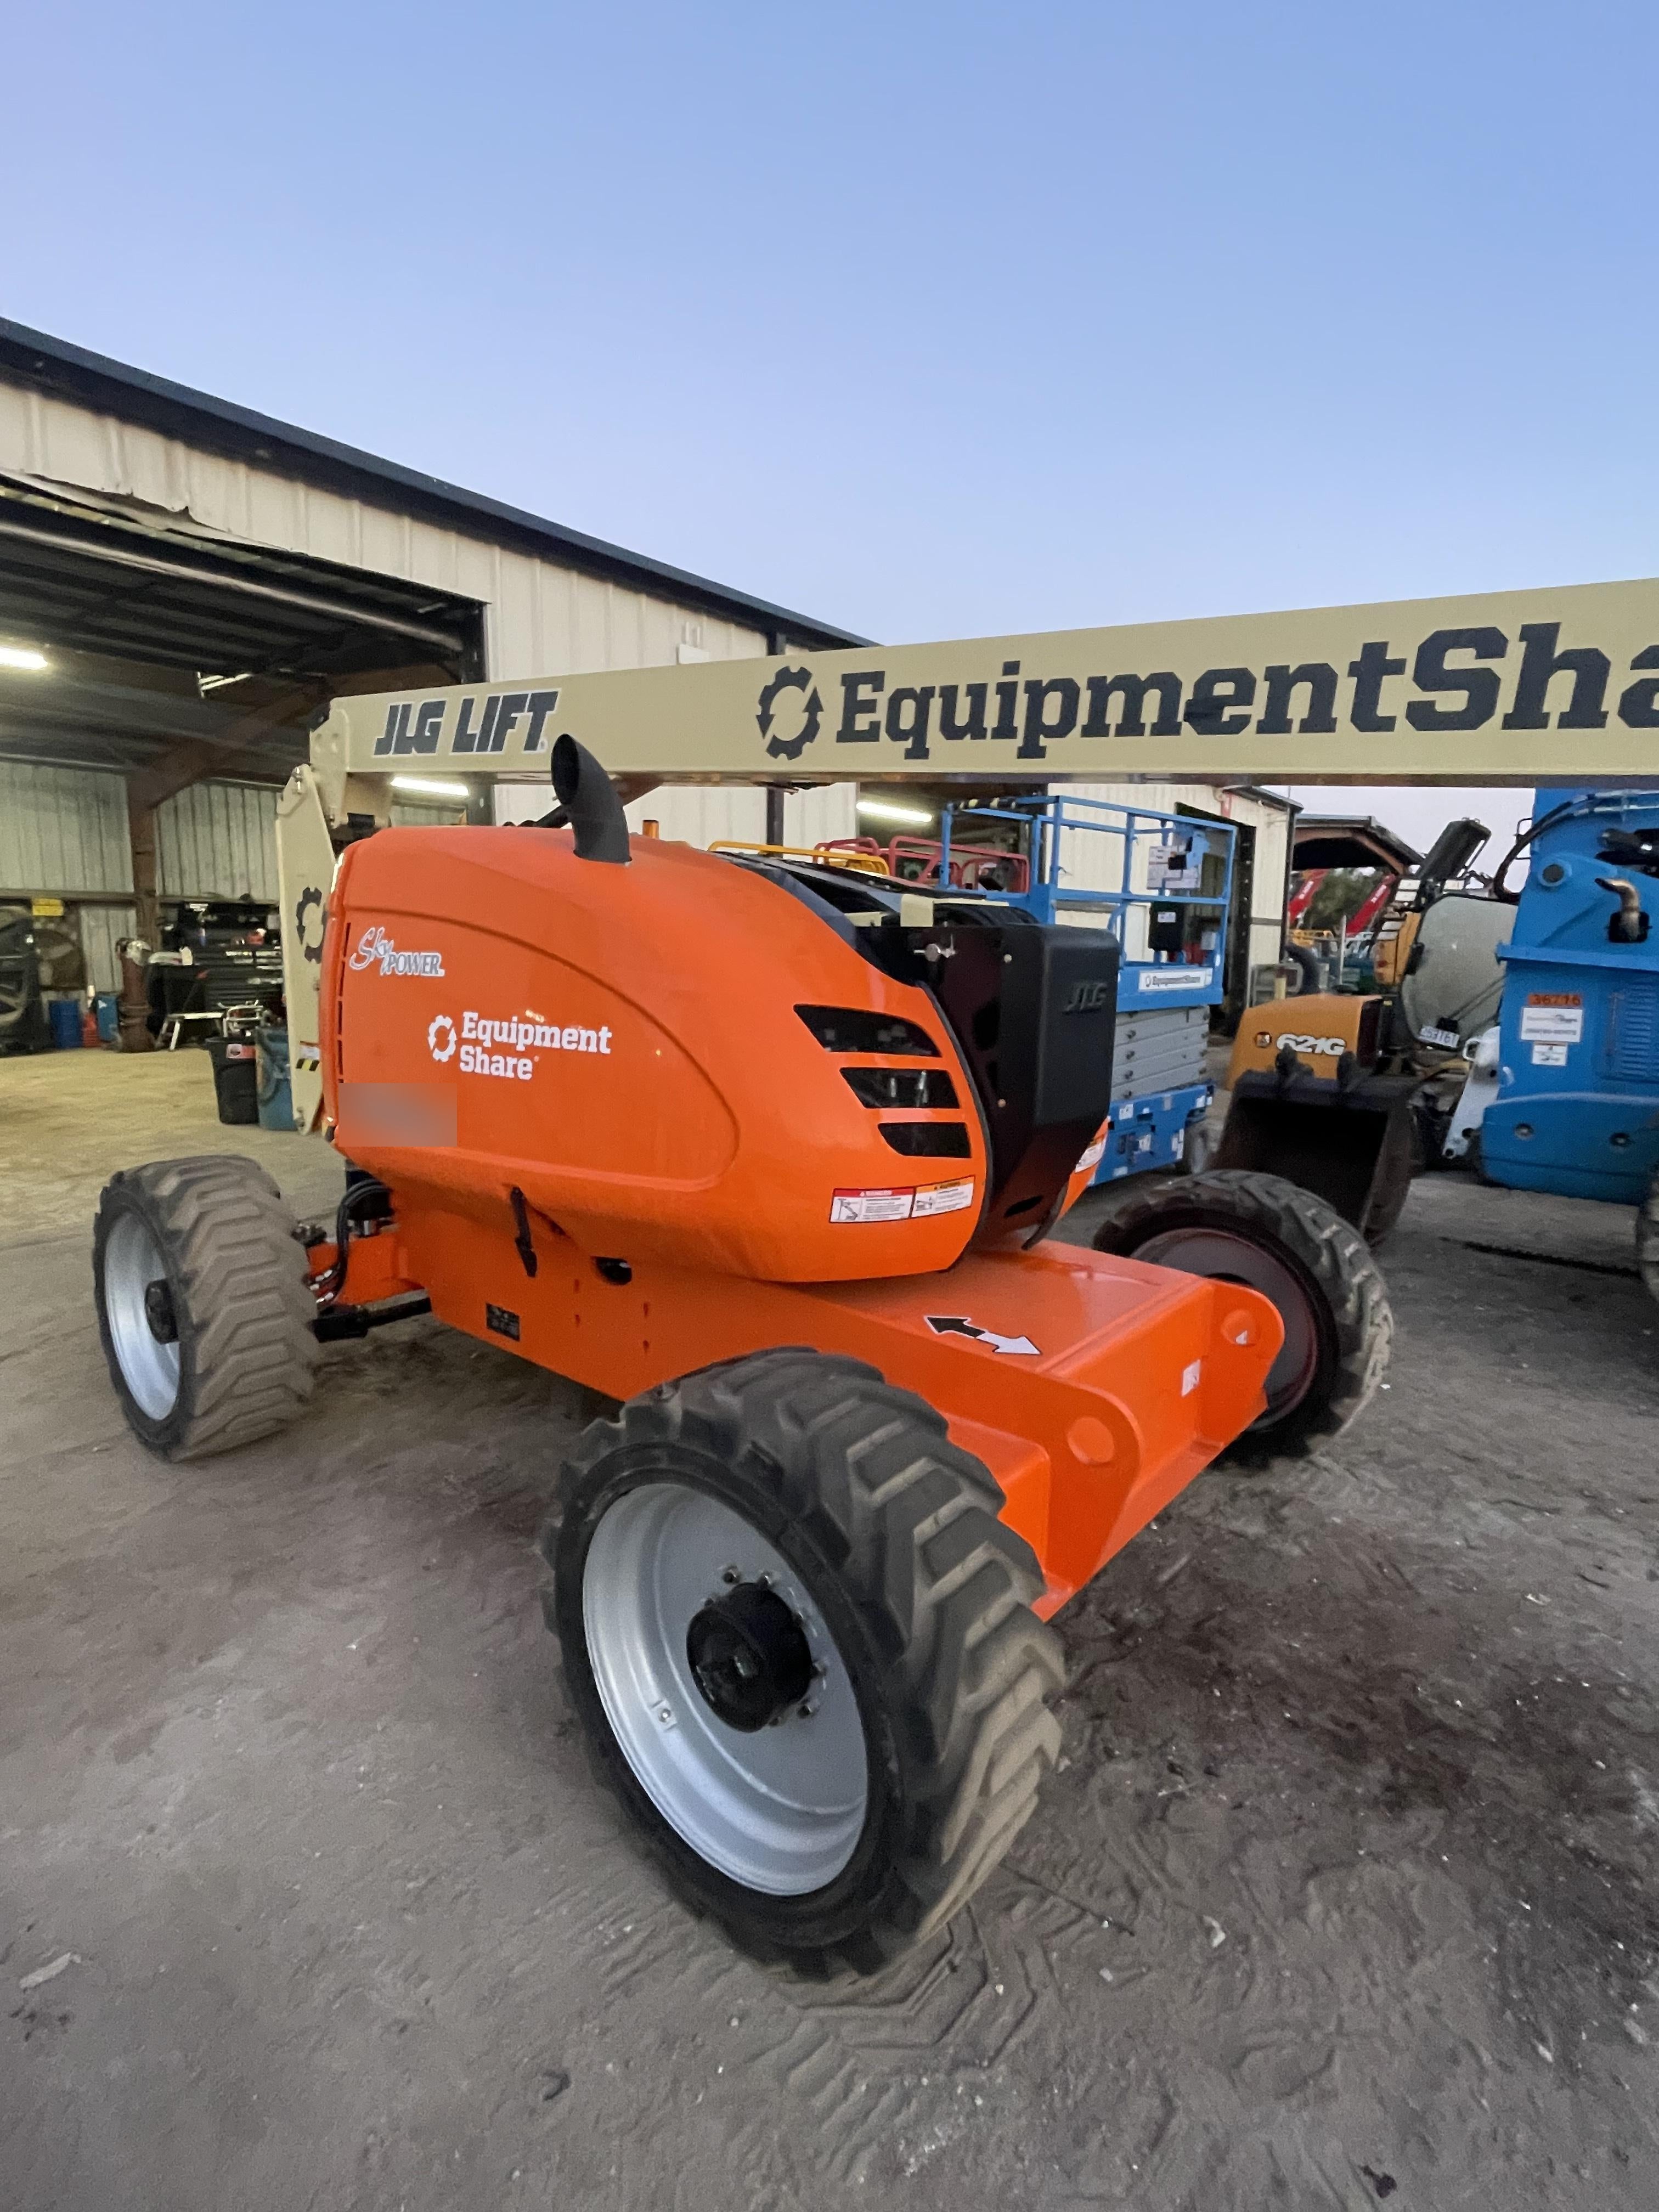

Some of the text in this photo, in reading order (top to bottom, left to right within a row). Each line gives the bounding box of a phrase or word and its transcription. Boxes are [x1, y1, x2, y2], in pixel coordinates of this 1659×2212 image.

[373, 690, 559, 756] JLG LIFT
[461, 1011, 612, 1054] Equipment
[1276, 1033, 1346, 1056] 621G
[459, 1045, 533, 1080] Share
